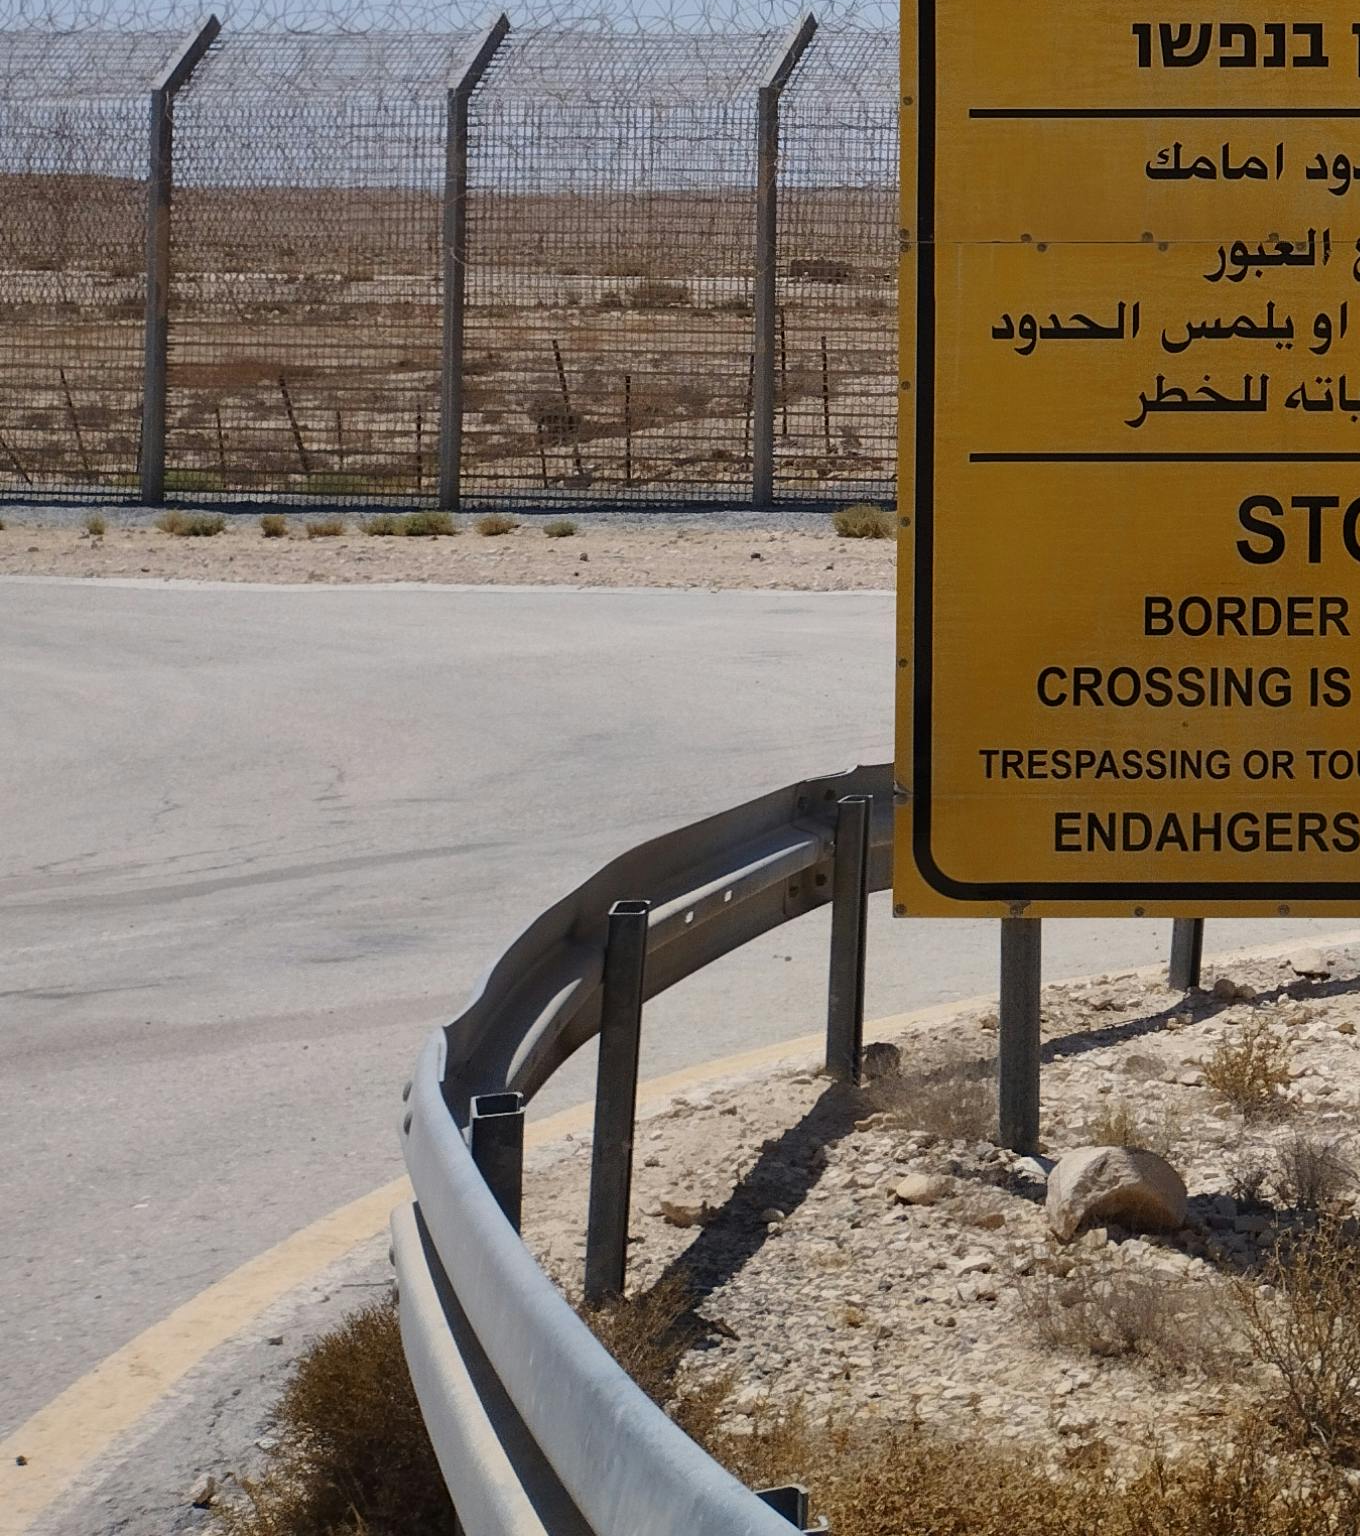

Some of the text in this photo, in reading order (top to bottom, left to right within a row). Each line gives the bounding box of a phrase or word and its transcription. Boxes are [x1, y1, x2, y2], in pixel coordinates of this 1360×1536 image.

[1131, 22, 1329, 68] בנפשו
[1145, 141, 1284, 180] امامك
[991, 301, 1140, 356] الحدود
[1161, 300, 1295, 354] يلمس
[1308, 301, 1348, 356] او
[1124, 373, 1270, 429] للخطر
[1144, 595, 1351, 637] BORDER
[1036, 666, 1292, 708] CROSSING
[1310, 666, 1352, 708] IS
[978, 749, 1231, 781] TRESPASSING
[1243, 749, 1295, 781] OR
[1053, 811, 1360, 853] ENDAHGERS
